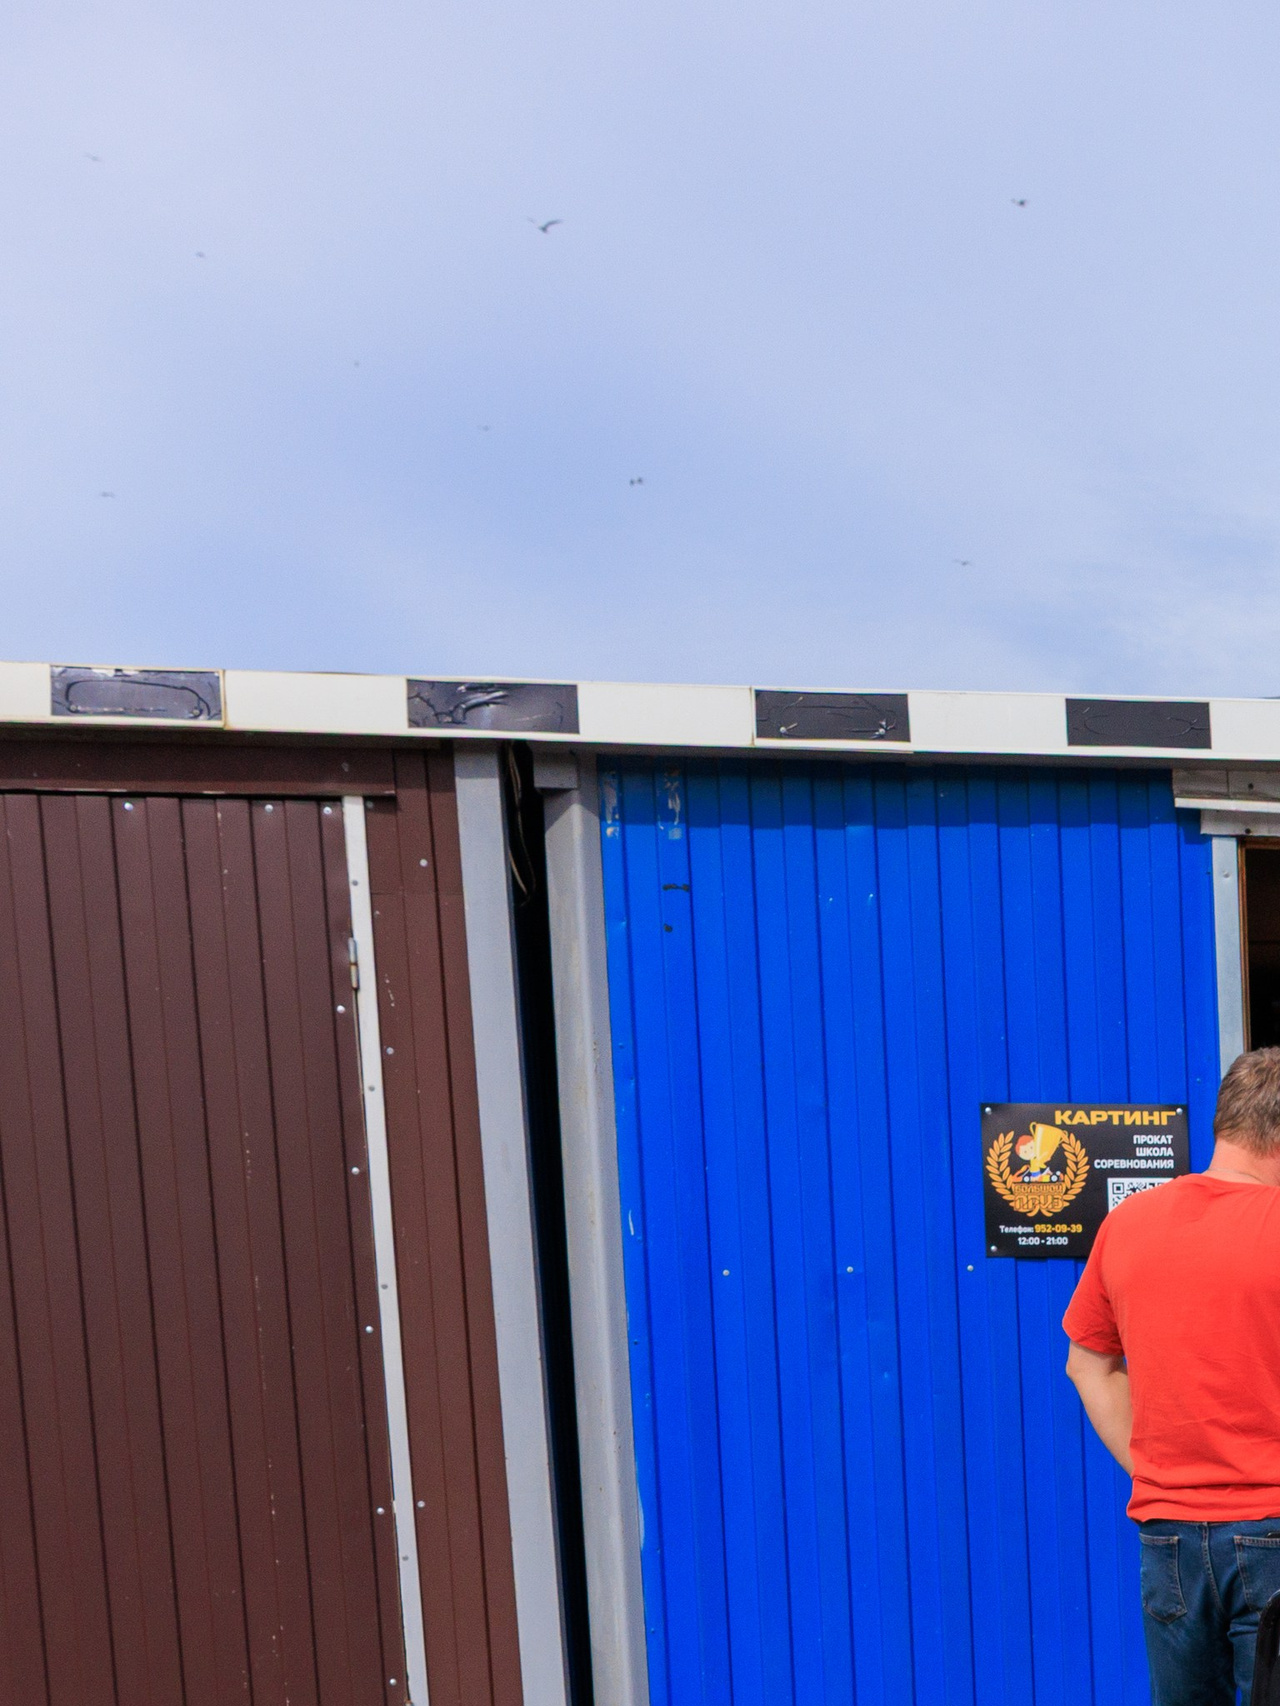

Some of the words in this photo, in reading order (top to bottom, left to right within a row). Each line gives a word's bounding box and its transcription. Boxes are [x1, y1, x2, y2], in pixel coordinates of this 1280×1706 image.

[1055, 1110, 1176, 1126] КАРТИНГ
[1133, 1135, 1173, 1145] ПРОКАТ
[1136, 1147, 1174, 1157] ШКОЛА
[1094, 1159, 1174, 1169] СОРЕВНОВАНИЯ
[1014, 1195, 1064, 1210] ПРИЗ
[999, 1225, 1034, 1234] Телефон:
[1034, 1224, 1082, 1233] 952-09-39
[1018, 1237, 1040, 1246] 12:00
[1046, 1237, 1068, 1246] 21:00
